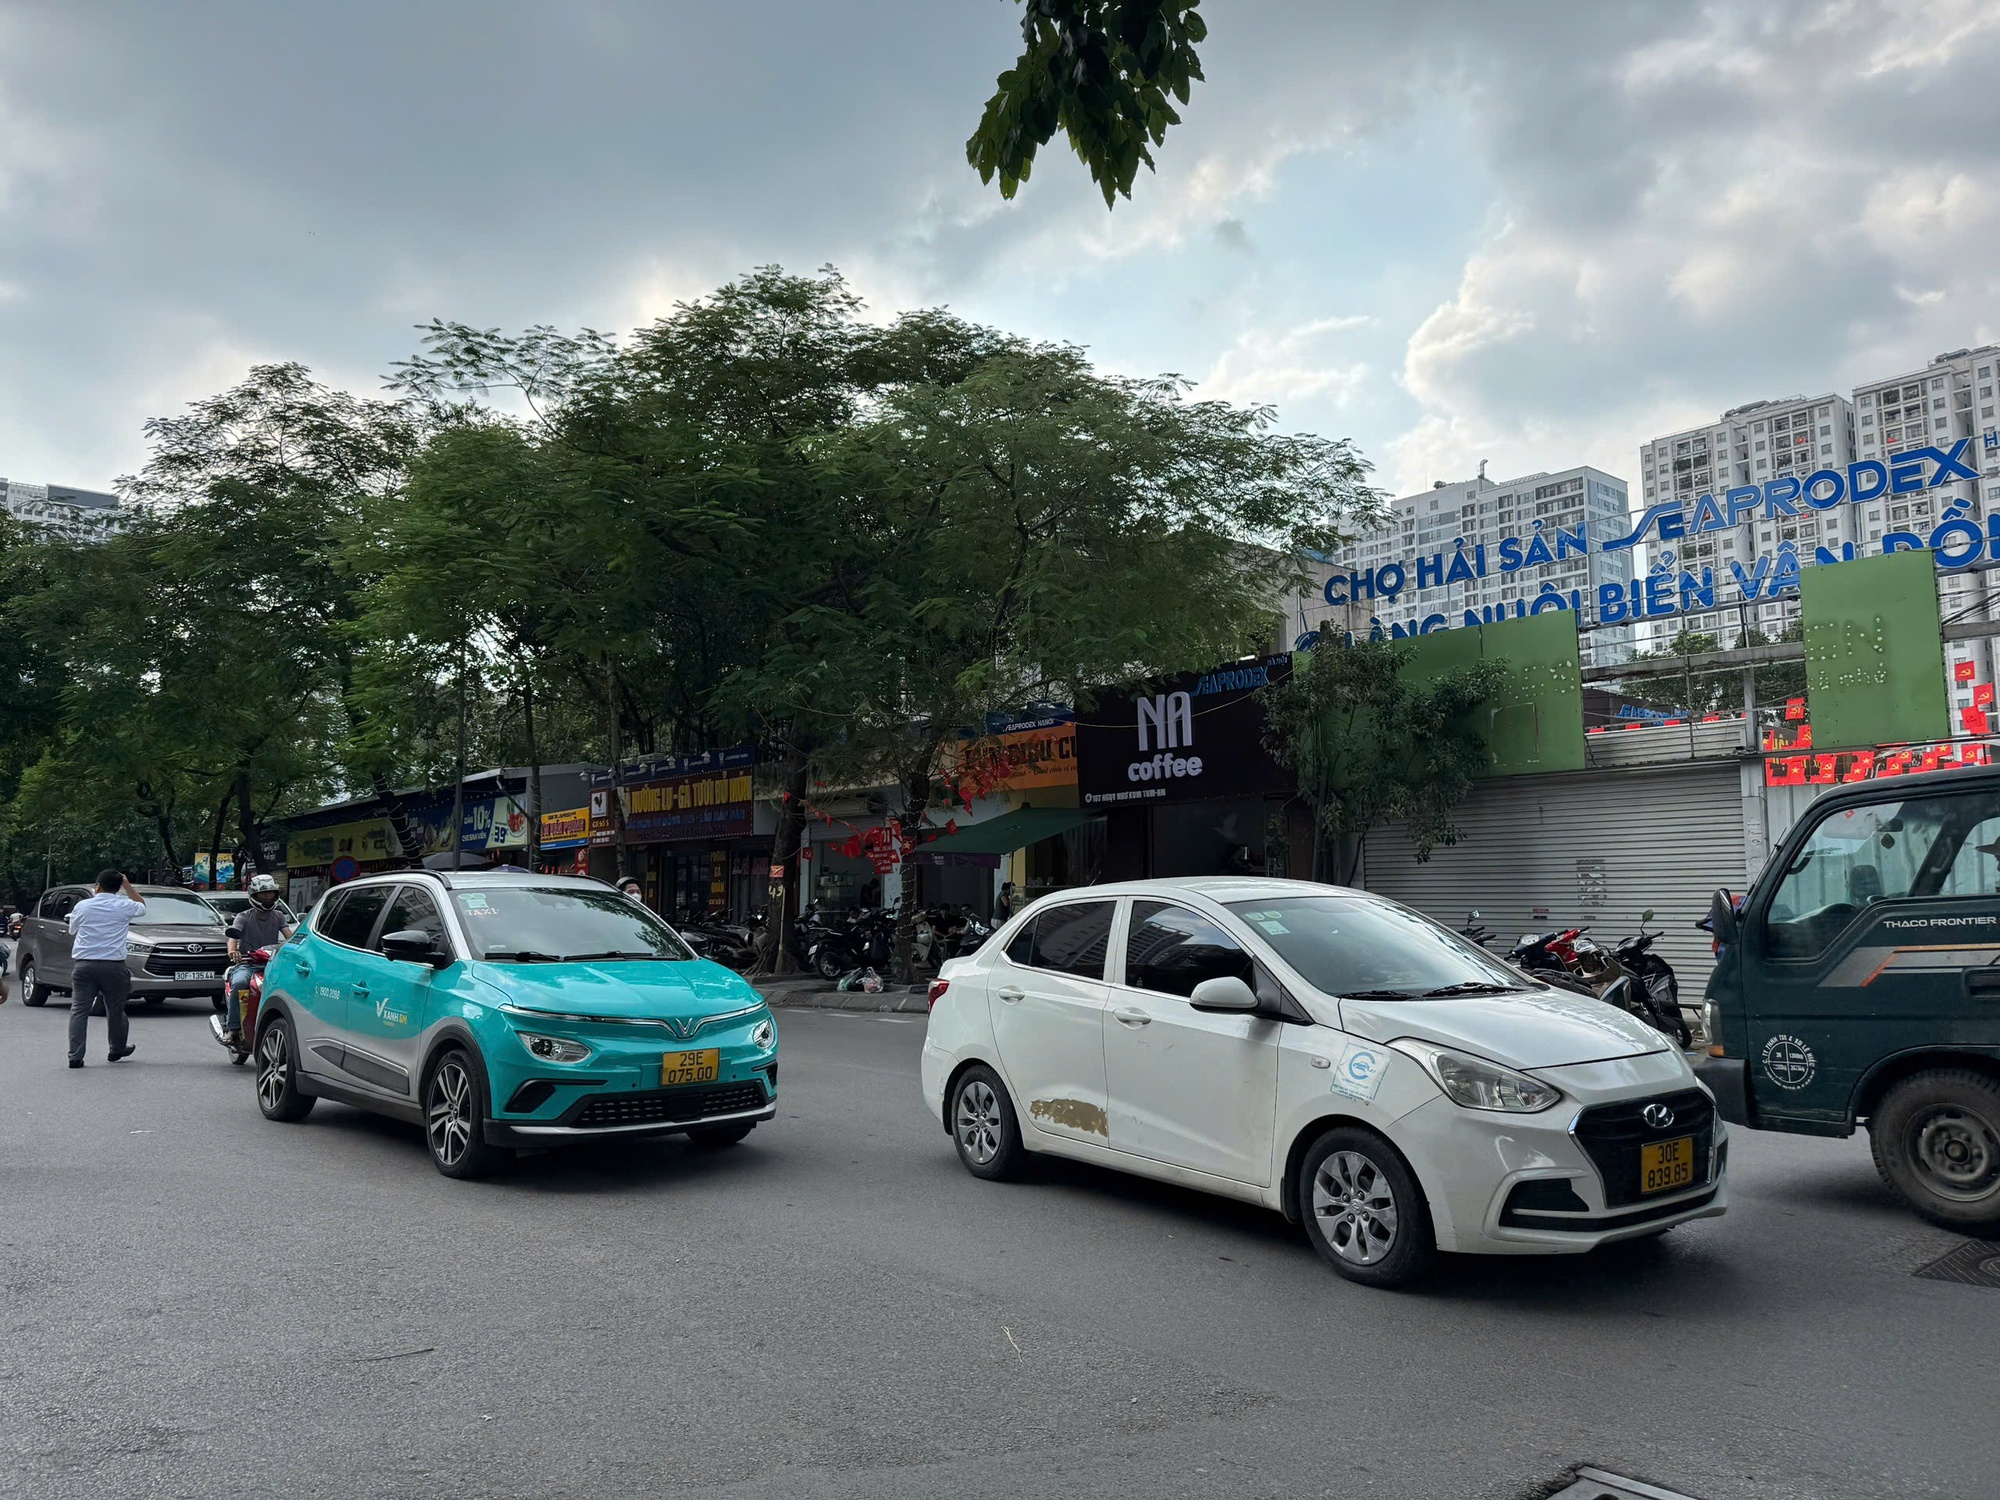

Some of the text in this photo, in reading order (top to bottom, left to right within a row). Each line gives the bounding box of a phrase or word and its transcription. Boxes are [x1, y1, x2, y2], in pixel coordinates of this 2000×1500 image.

[1323, 559, 1406, 605] CHỢ
[1416, 537, 1487, 590] HẢI
[1499, 519, 1588, 572] SẢN
[1602, 437, 1981, 551] SEAPRODEX
[1599, 551, 1715, 624] BIỂN
[1190, 666, 1270, 699] SEAPRODEX
[1137, 691, 1193, 751] NA
[1128, 752, 1203, 782] coffee
[465, 907, 498, 916] TAXI
[1883, 916, 1997, 929] THACO FRONTIER
[382, 1009, 400, 1022] XANH
[399, 1013, 408, 1024] SM
[679, 1051, 704, 1067] 29E
[668, 1066, 713, 1083] 075.00
[1657, 1142, 1679, 1164] 30E
[1647, 1162, 1689, 1189] 839.85
